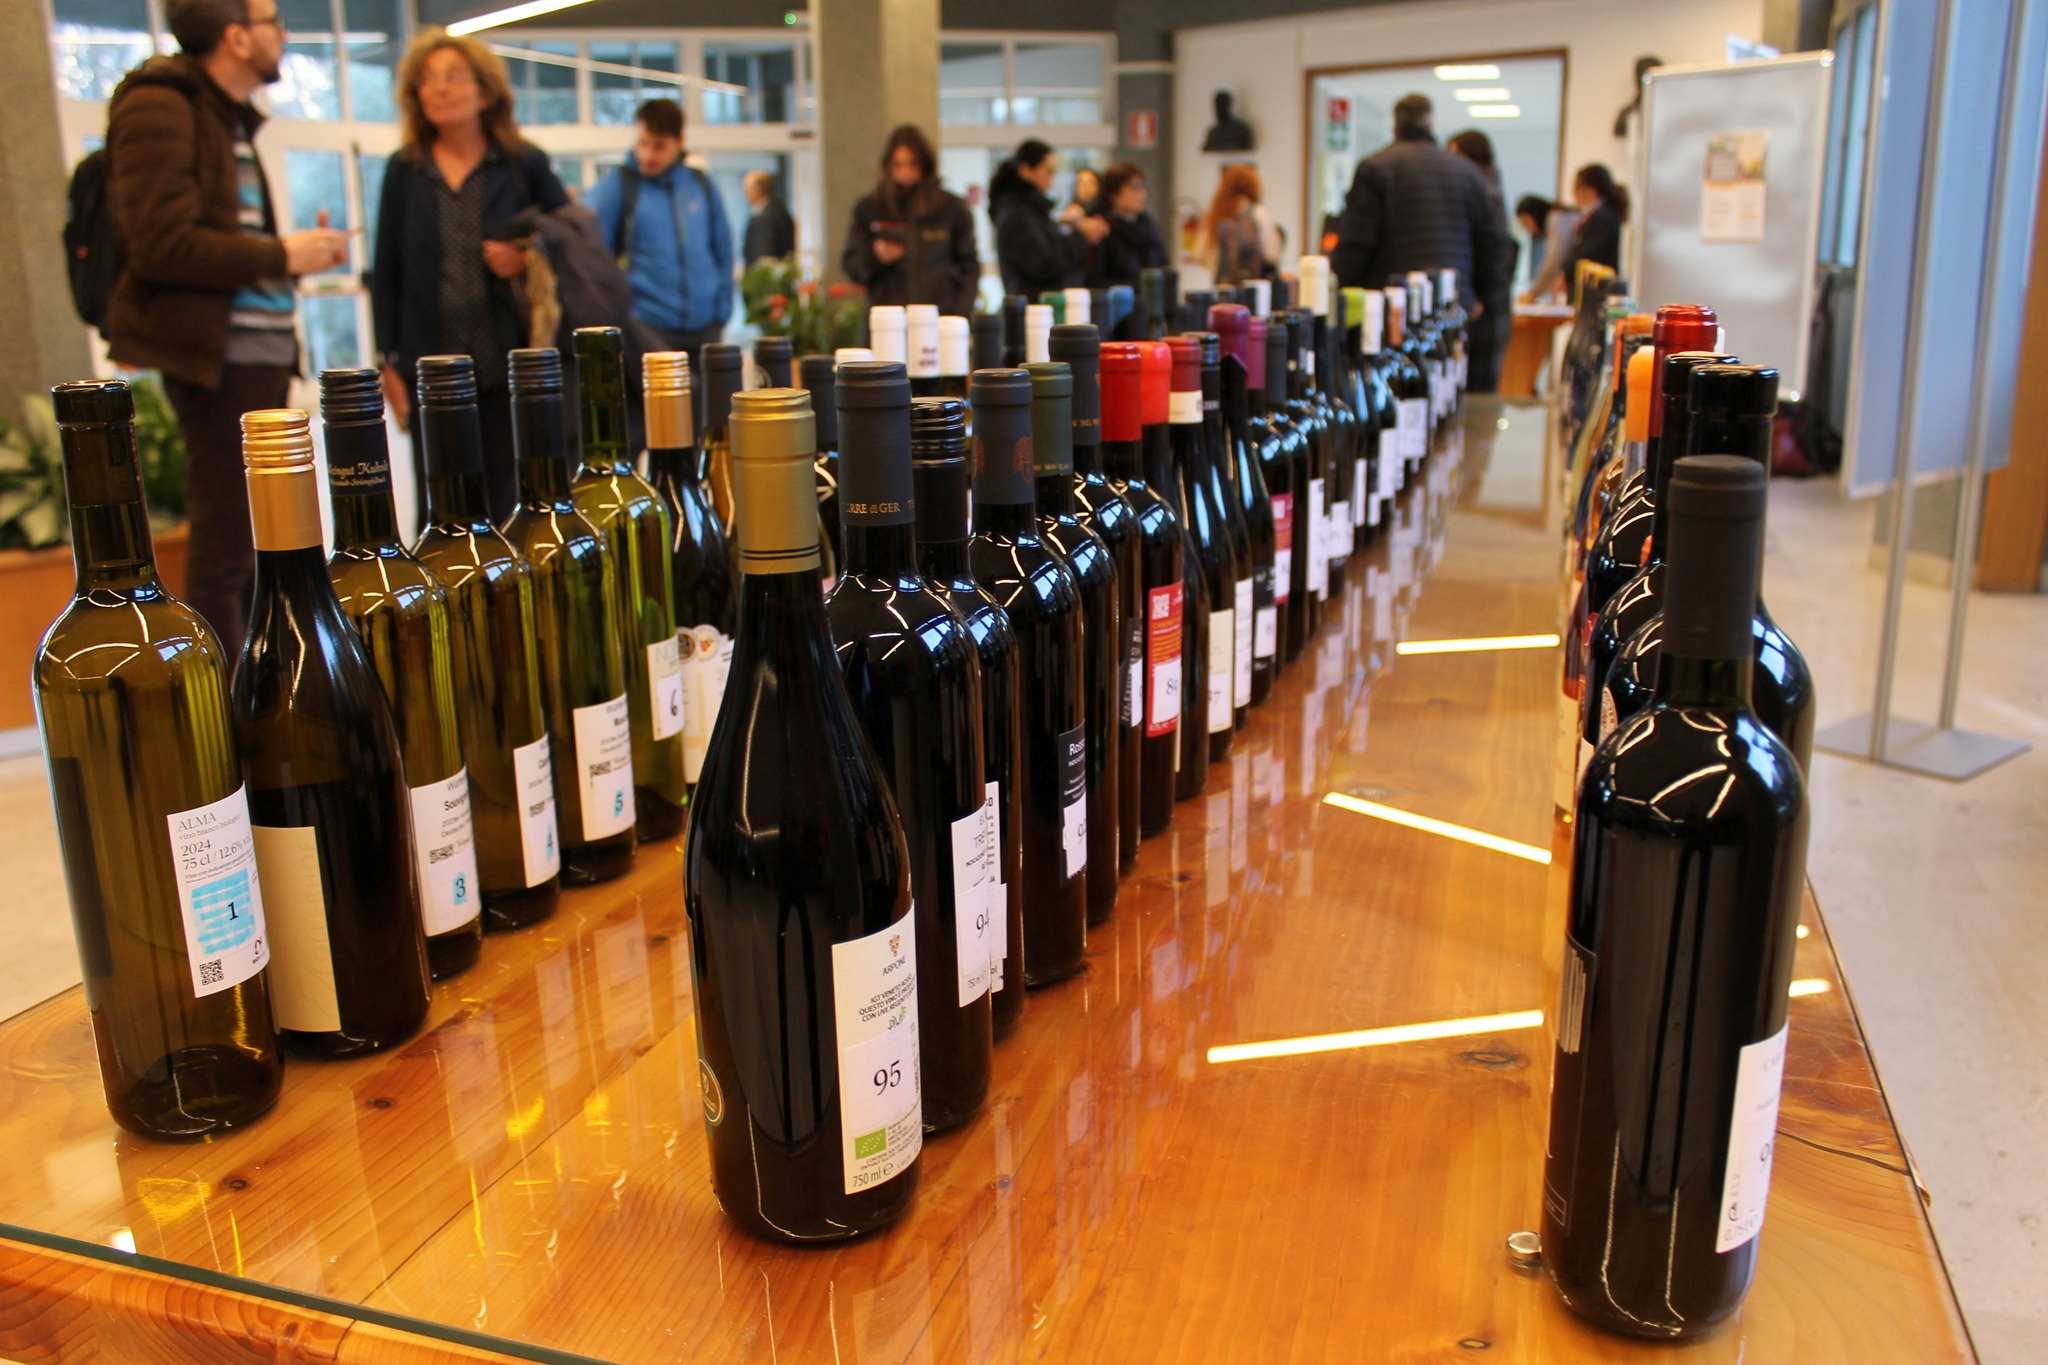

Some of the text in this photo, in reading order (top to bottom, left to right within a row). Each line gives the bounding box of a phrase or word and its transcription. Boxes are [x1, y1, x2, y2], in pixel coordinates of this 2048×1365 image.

[670, 688, 678, 716] 6
[615, 792, 624, 812] 5
[178, 812, 217, 832] ALMA
[181, 840, 211, 857] 2024
[182, 857, 198, 870] 75
[200, 853, 210, 866] cl
[455, 878, 466, 898] 3
[226, 901, 239, 920] 1
[859, 1000, 885, 1016] QUESTO
[862, 1011, 877, 1022] CON
[873, 1060, 901, 1096] 95
[852, 1172, 869, 1188] 750
[870, 1167, 882, 1182] ml
